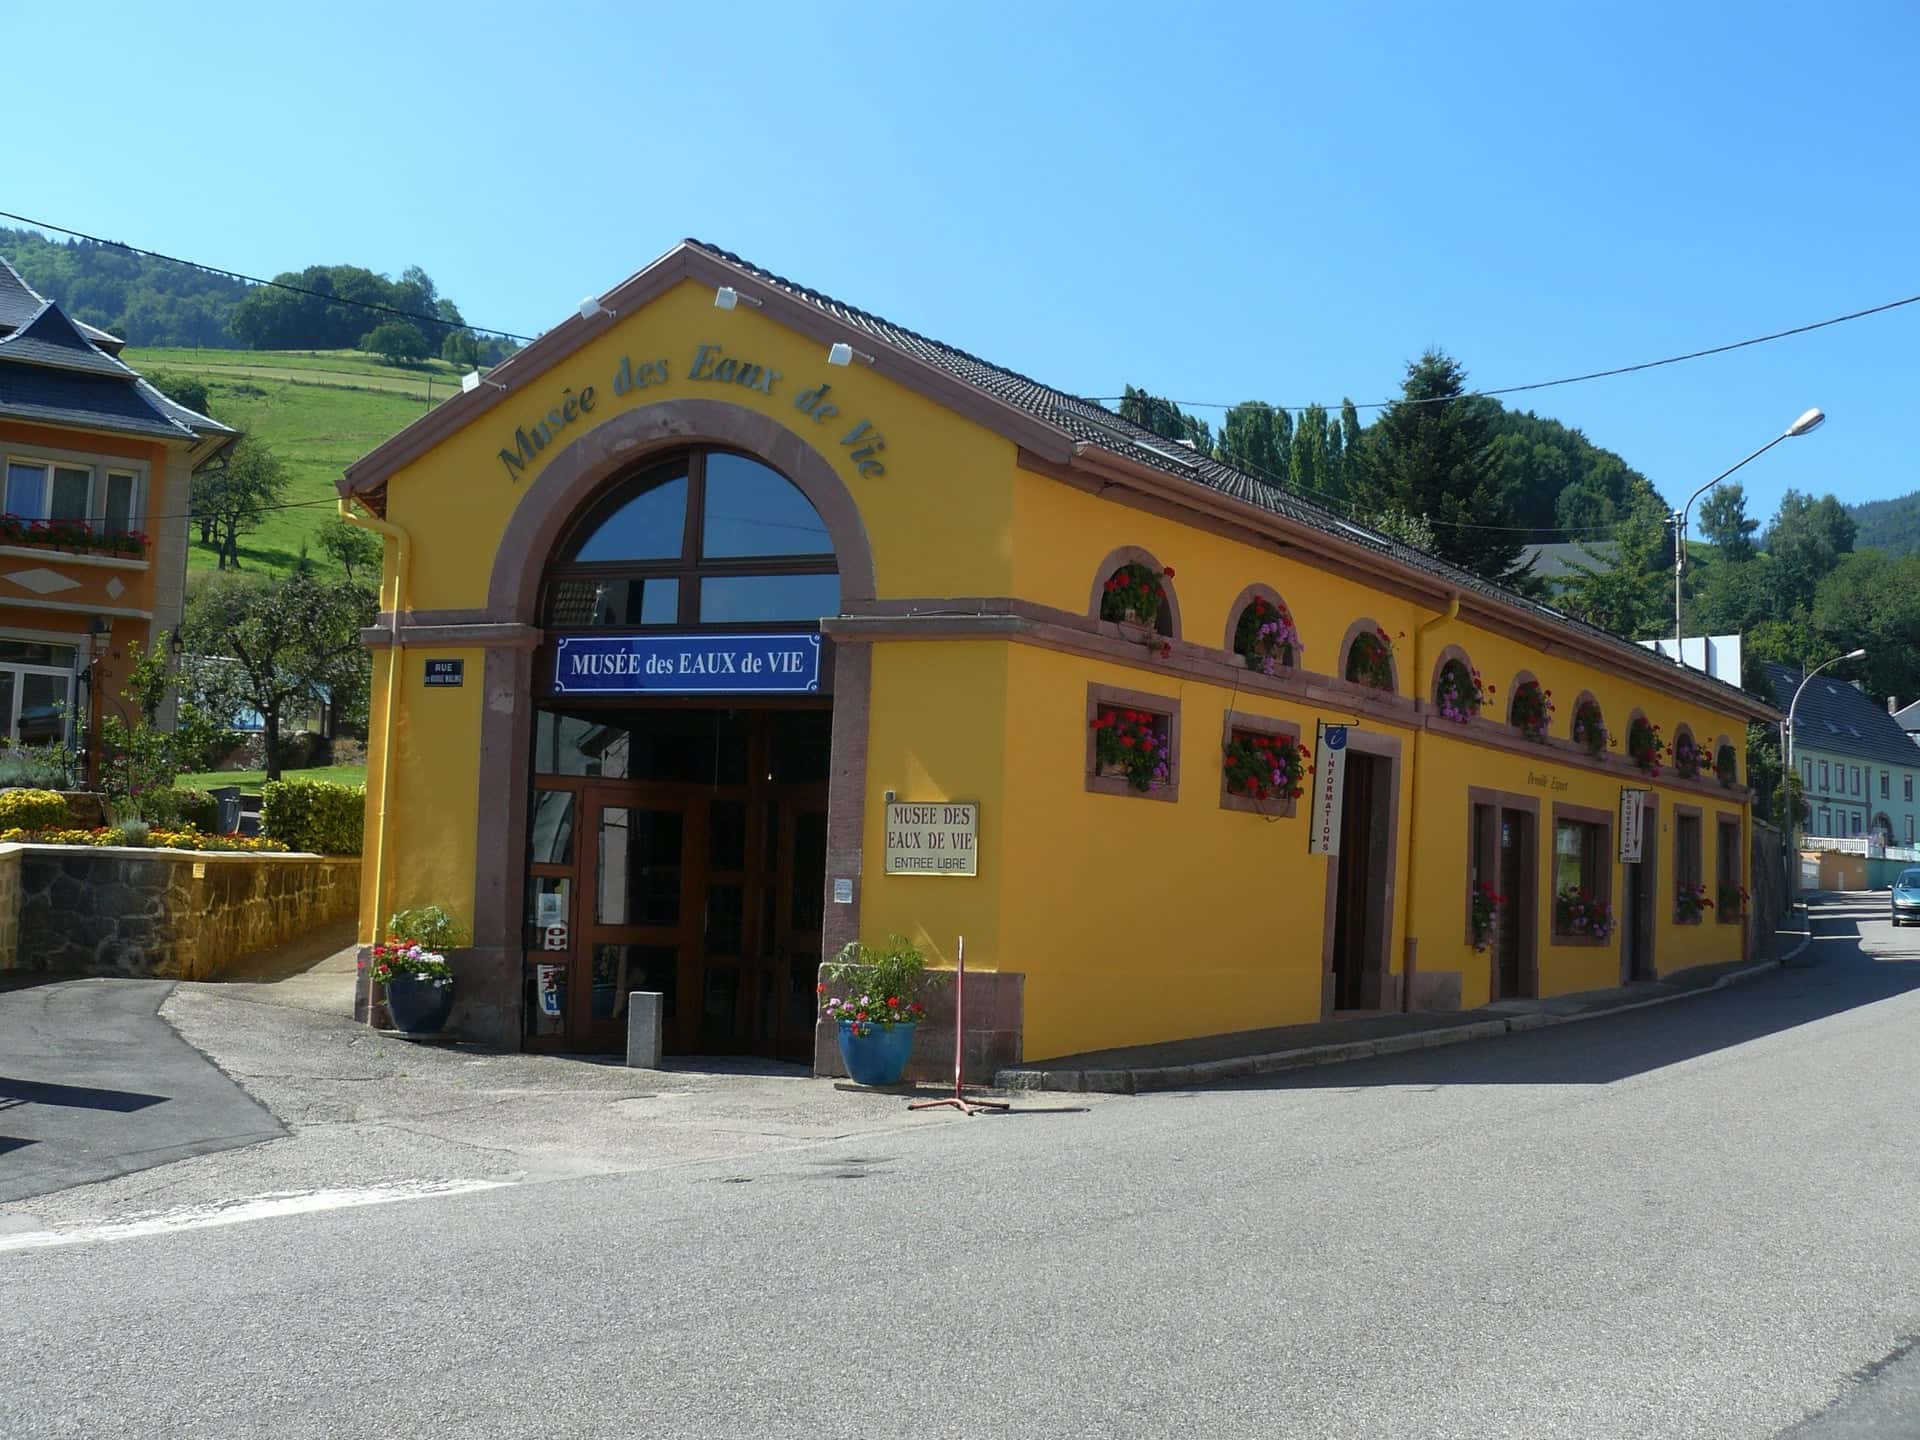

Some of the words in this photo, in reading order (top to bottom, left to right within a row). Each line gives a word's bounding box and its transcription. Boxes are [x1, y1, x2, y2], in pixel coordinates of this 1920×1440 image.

[612, 354, 670, 396] des
[688, 343, 784, 396] Eaux
[794, 382, 840, 425] de
[839, 417, 888, 481] Vie
[571, 647, 641, 675] MUSÉE
[646, 653, 674, 674] des
[679, 652, 737, 674] EAUX
[741, 652, 762, 673] de
[768, 651, 804, 673] VIE
[1322, 752, 1335, 851] INFORMATIONS
[894, 807, 937, 824] MUSEE
[944, 807, 970, 825] DES
[888, 832, 921, 848] EAUX
[928, 832, 945, 849] DE
[952, 832, 972, 849] VIE
[895, 857, 933, 869] ENTREE
[938, 857, 966, 869] LIBRE
